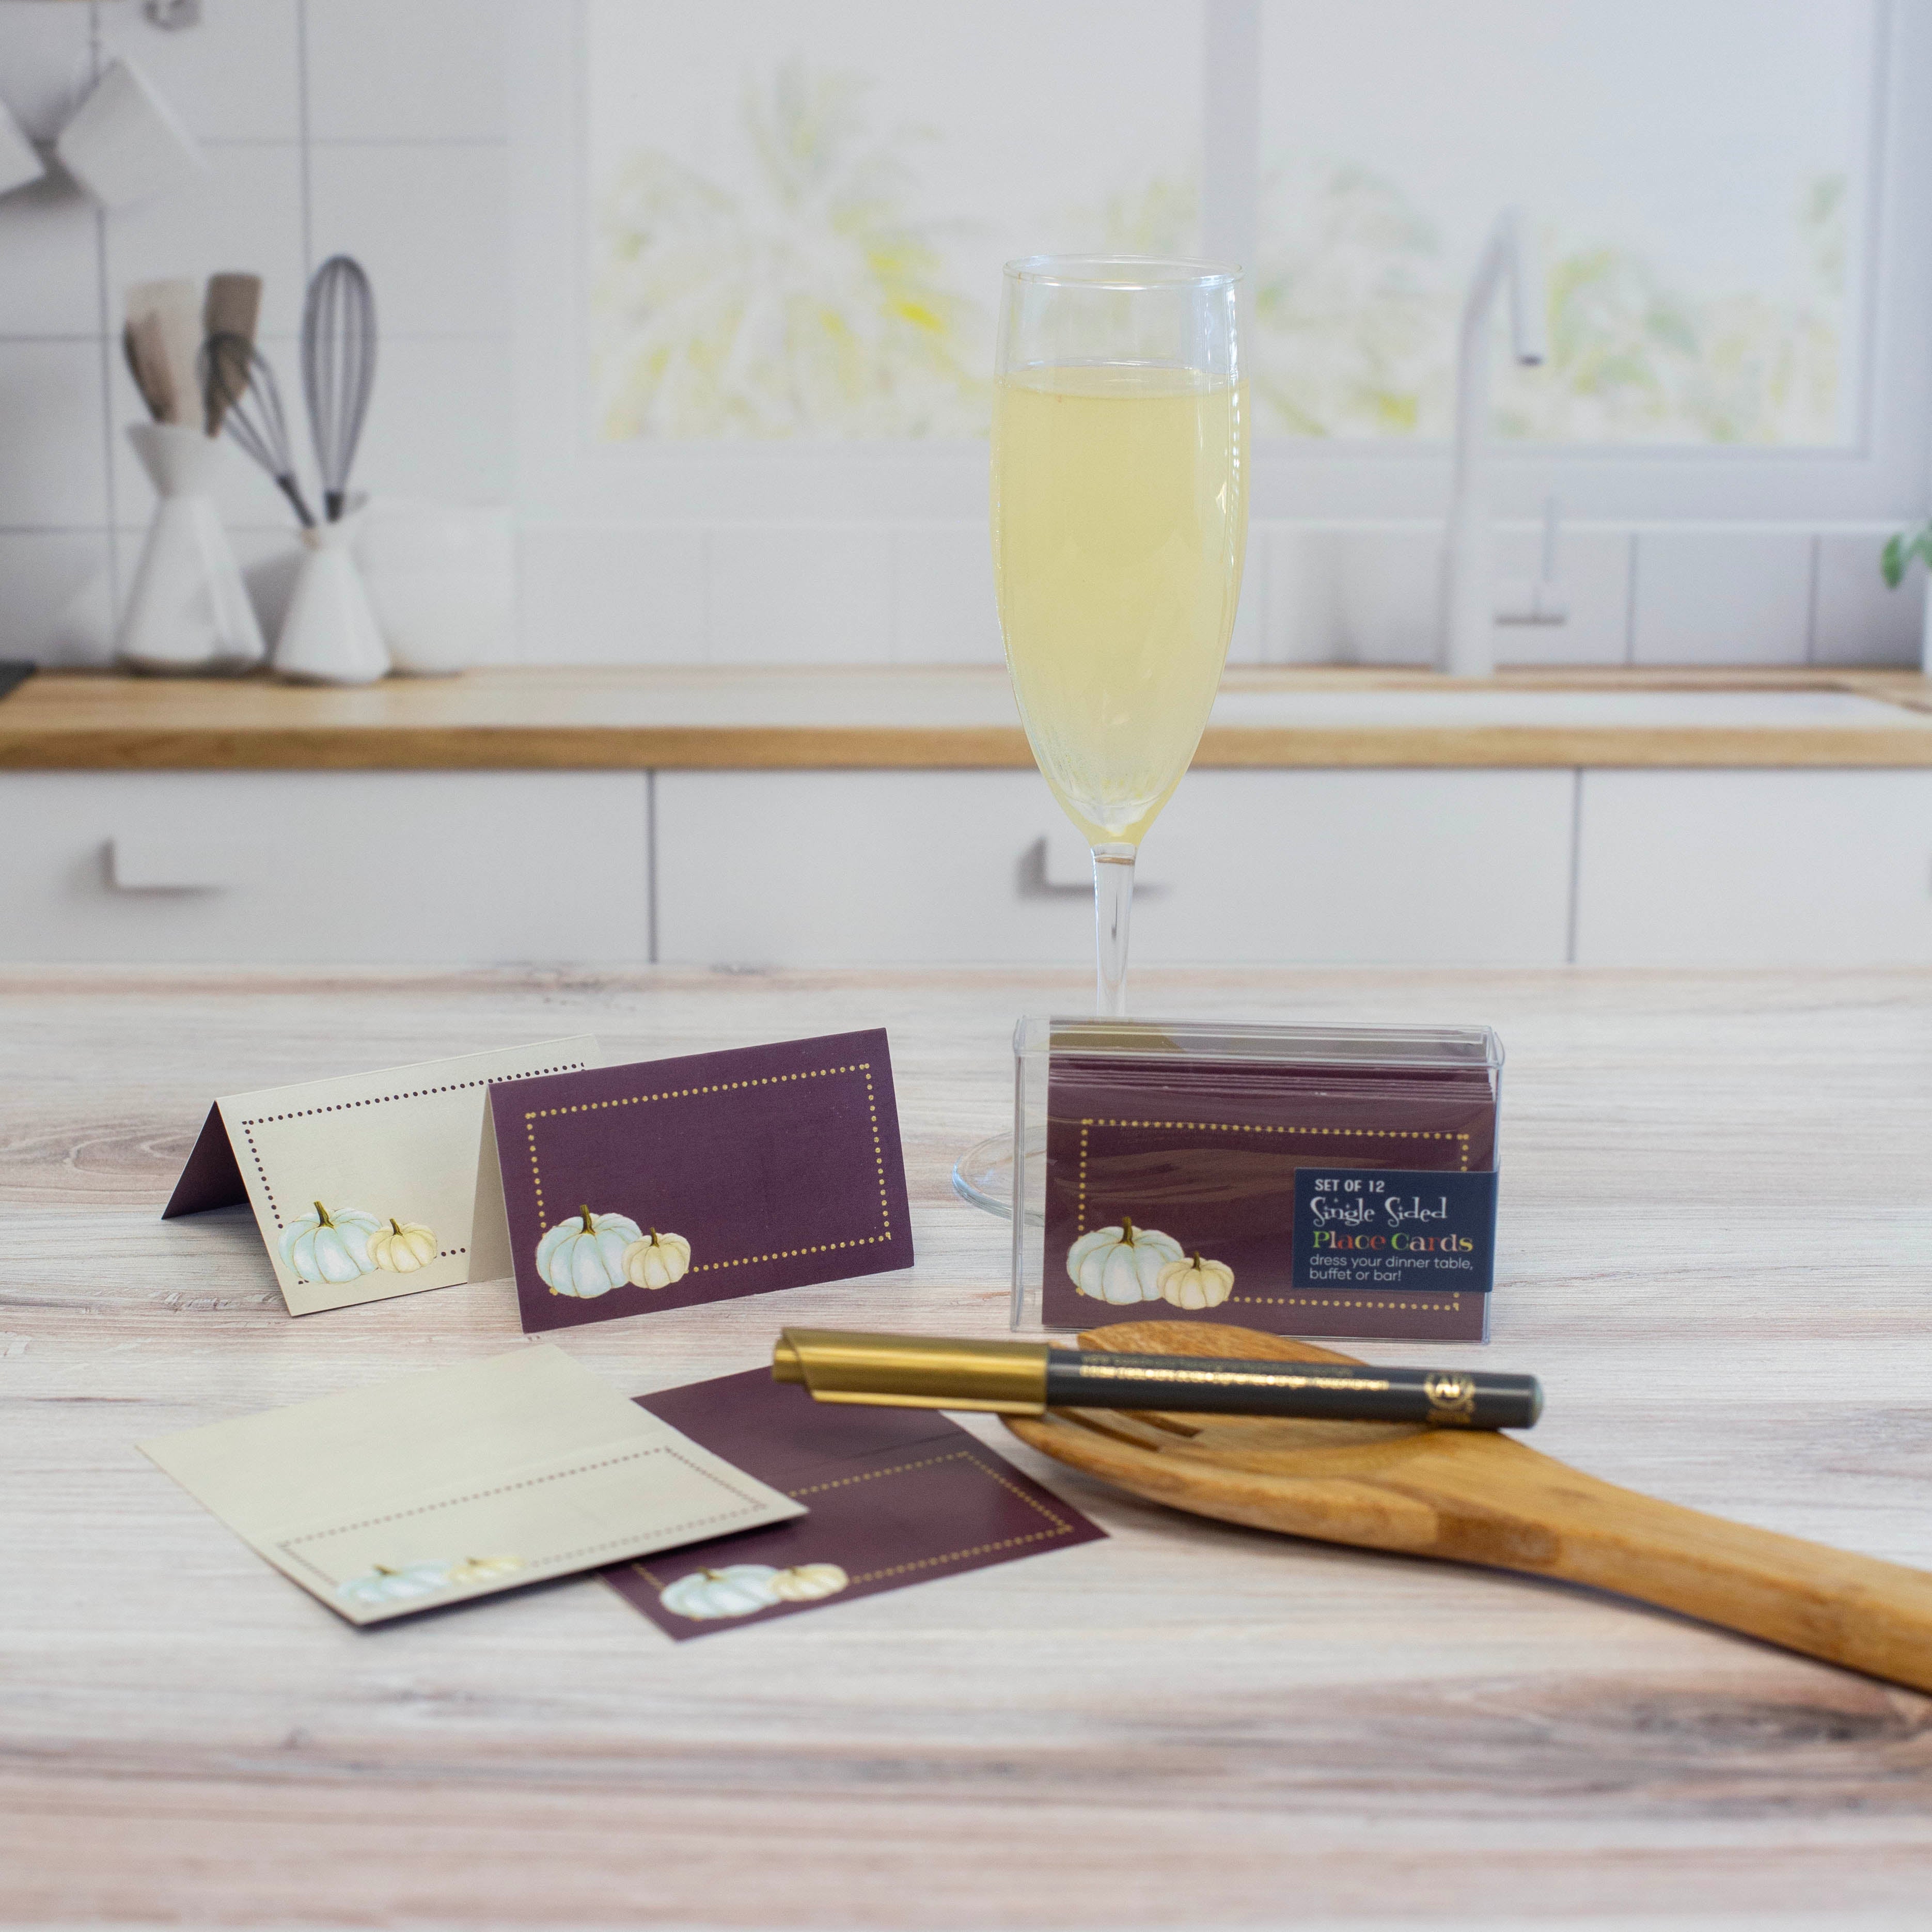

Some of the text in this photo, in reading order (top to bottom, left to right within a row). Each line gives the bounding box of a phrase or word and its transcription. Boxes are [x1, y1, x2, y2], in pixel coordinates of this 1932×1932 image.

[1315, 1179, 1385, 1192] SET OF 12
[1310, 1196, 1447, 1227] Single Sided
[1313, 1231, 1474, 1252] Place Cards
[1310, 1254, 1473, 1270] dress your dinner table,
[1310, 1268, 1401, 1281] buffet or bar!
